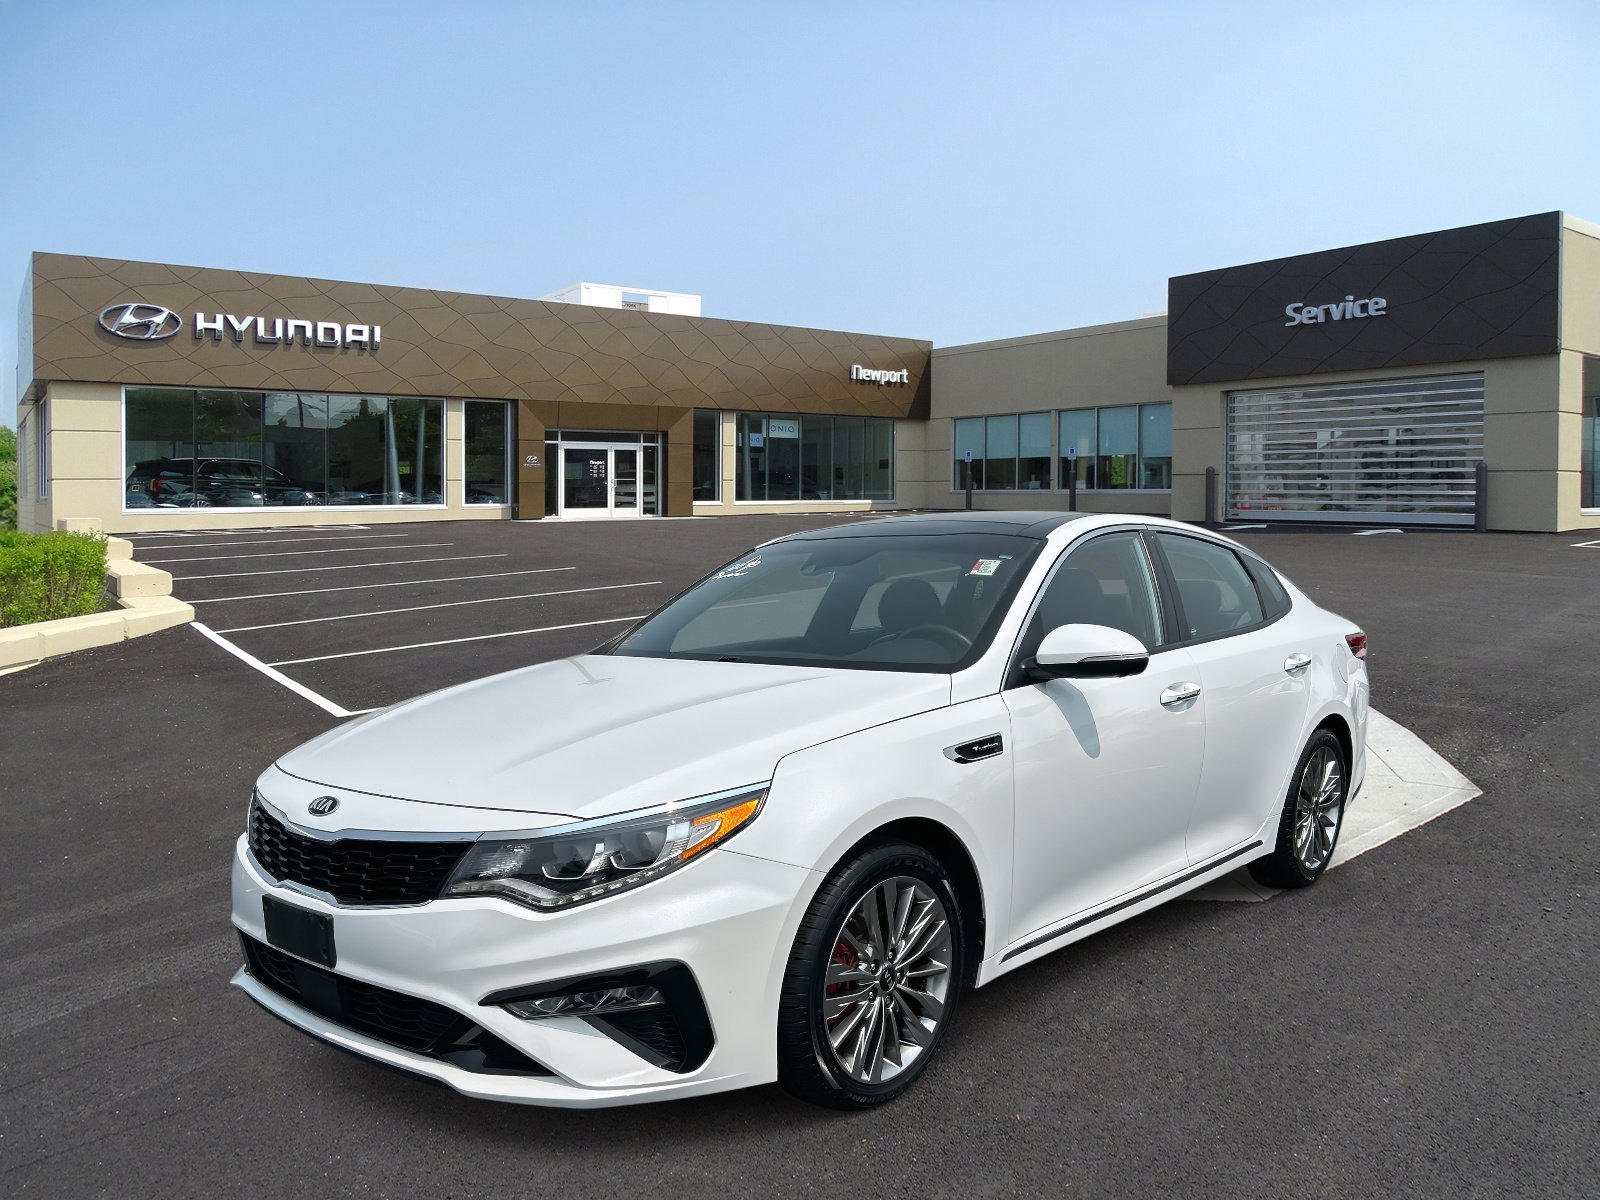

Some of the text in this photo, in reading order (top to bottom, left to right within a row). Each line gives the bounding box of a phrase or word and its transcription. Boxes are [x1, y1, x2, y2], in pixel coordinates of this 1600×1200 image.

[1285, 295, 1387, 327] Service
[195, 312, 381, 350] HYUNDAI
[850, 364, 909, 385] Newport
[310, 798, 334, 813] KIA
